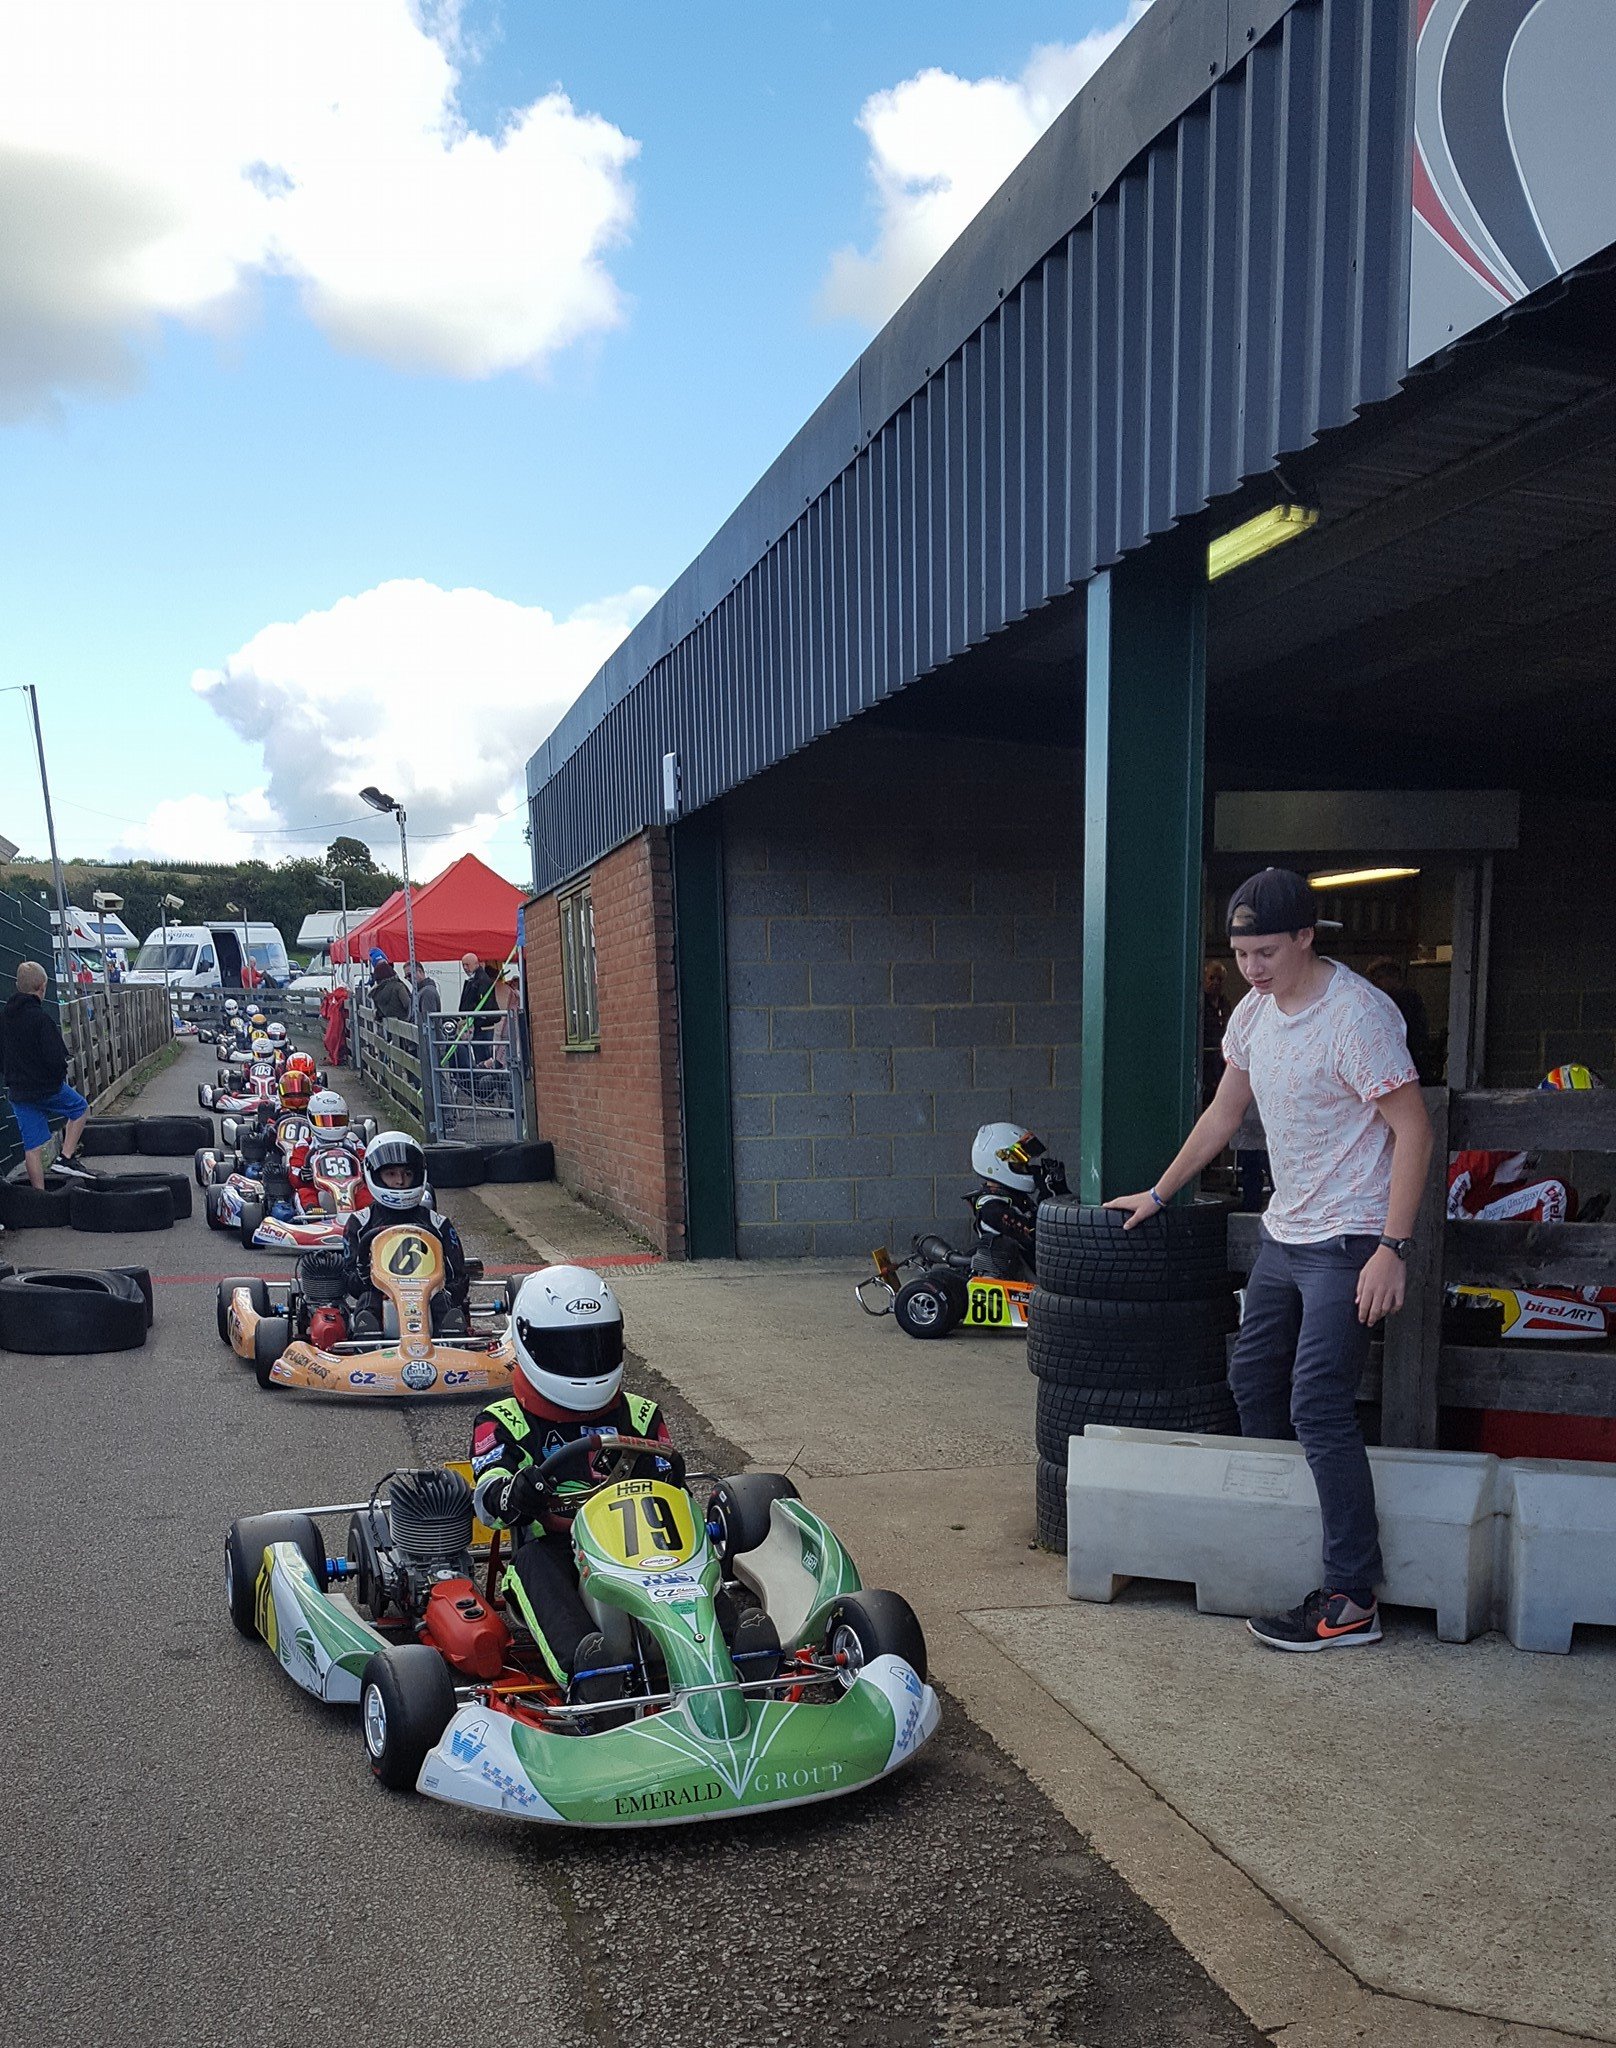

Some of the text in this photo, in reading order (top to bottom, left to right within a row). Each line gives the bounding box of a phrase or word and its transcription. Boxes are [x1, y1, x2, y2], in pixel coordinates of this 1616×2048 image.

[254, 1065, 271, 1076] 103
[325, 1156, 351, 1176] 53
[388, 1236, 429, 1276] 6
[569, 1300, 598, 1311] Arai
[971, 1287, 1003, 1324] 80
[493, 1404, 522, 1428] HRX
[637, 1400, 653, 1424] HRX
[608, 1496, 683, 1558] 79
[615, 1763, 843, 1815] EMERALD GROUP
